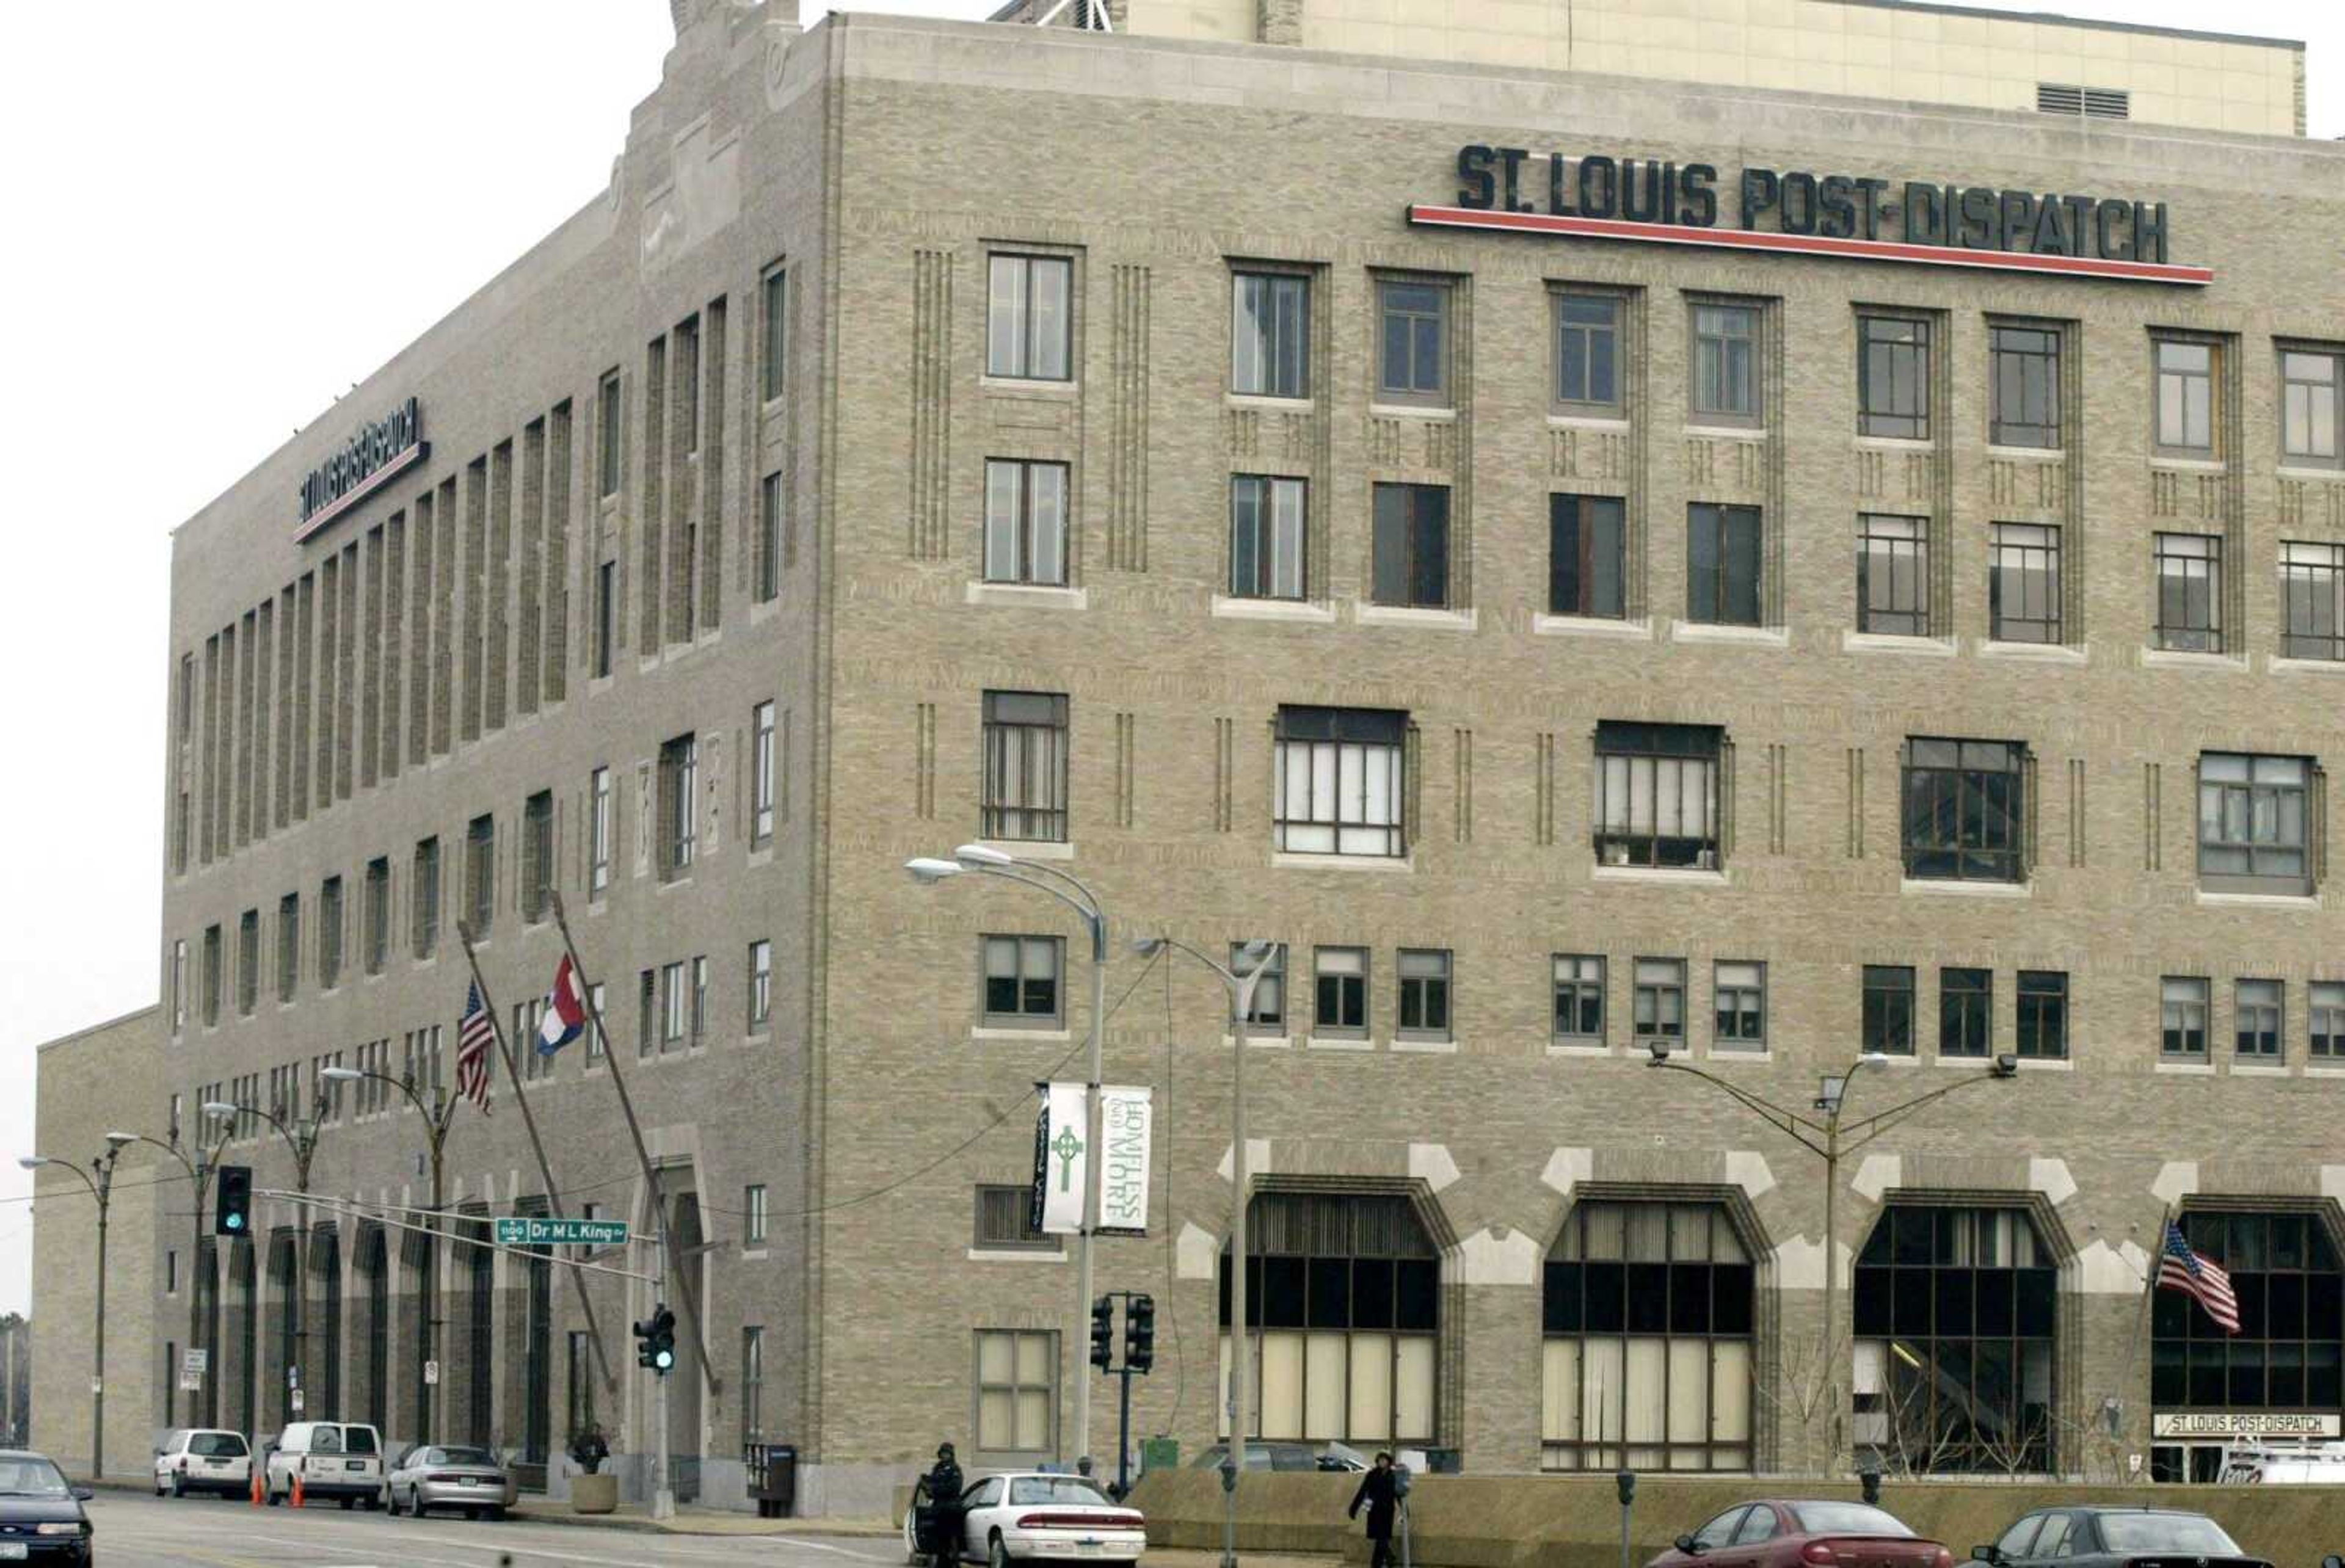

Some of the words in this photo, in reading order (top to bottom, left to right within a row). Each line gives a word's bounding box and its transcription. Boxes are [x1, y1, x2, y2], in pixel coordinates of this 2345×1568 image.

[1457, 145, 1534, 212] ST.
[1550, 152, 1718, 228] LOUIS
[1741, 168, 2168, 265] POST-DISPATCH
[531, 1223, 550, 1236] Dr
[552, 1224, 565, 1237] M
[567, 1224, 576, 1238] L
[580, 1224, 612, 1242] King
[2190, 1417, 2227, 1431] LOUIS
[2231, 1416, 2321, 1431] POST-DISPATCH
